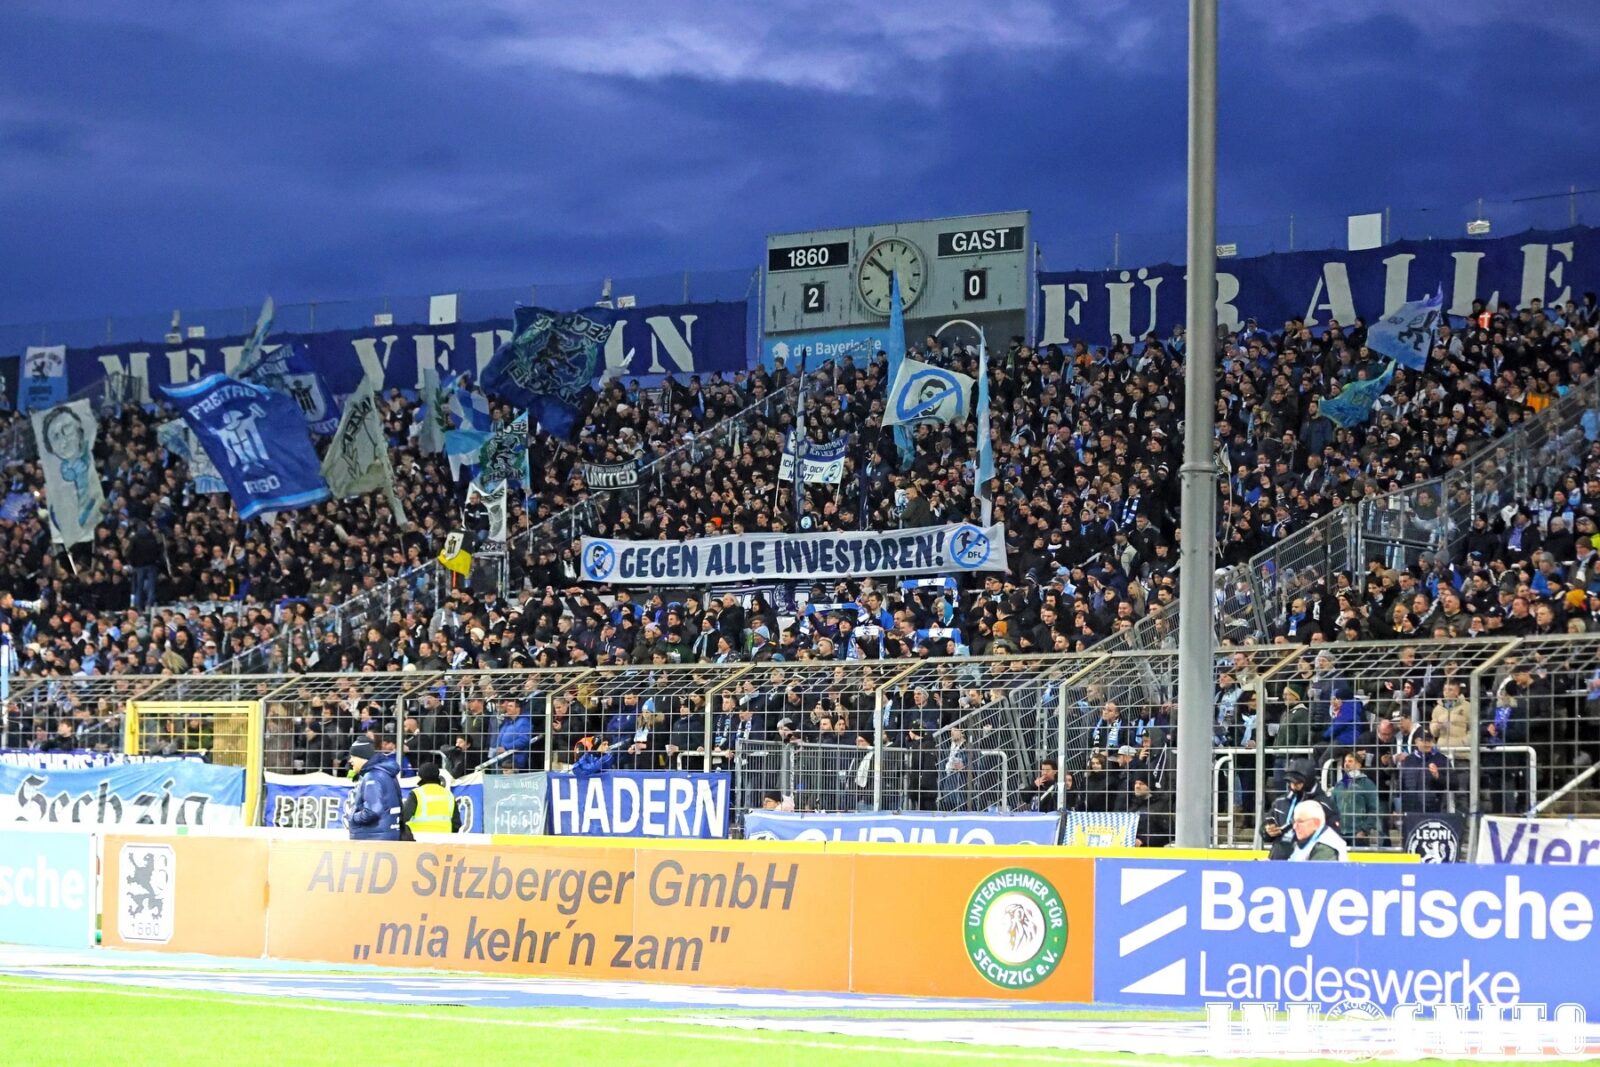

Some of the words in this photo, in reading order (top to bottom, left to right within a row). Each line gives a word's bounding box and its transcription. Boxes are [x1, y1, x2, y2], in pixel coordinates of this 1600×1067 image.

[787, 247, 829, 267] 1860
[952, 229, 1009, 252] GAST
[808, 287, 820, 308] 2
[968, 275, 980, 296] 0
[1304, 241, 1576, 328] ALLE
[585, 469, 638, 487] UNITED
[619, 542, 699, 579] GEGEN
[705, 541, 765, 576] ALLE
[775, 531, 945, 574] INVESTOREN!
[551, 777, 727, 837] HADERN
[1416, 828, 1452, 840] LEONI
[308, 852, 398, 894] AHD
[411, 852, 635, 915] Sitzberger
[648, 859, 798, 911] GmbH
[968, 873, 1049, 927] UNTERNEHMER
[1045, 898, 1063, 929] FÜR
[1201, 870, 1594, 948] Bayerische
[973, 948, 1035, 985] SECHZIG
[1200, 950, 1521, 1008] Landeswerke
